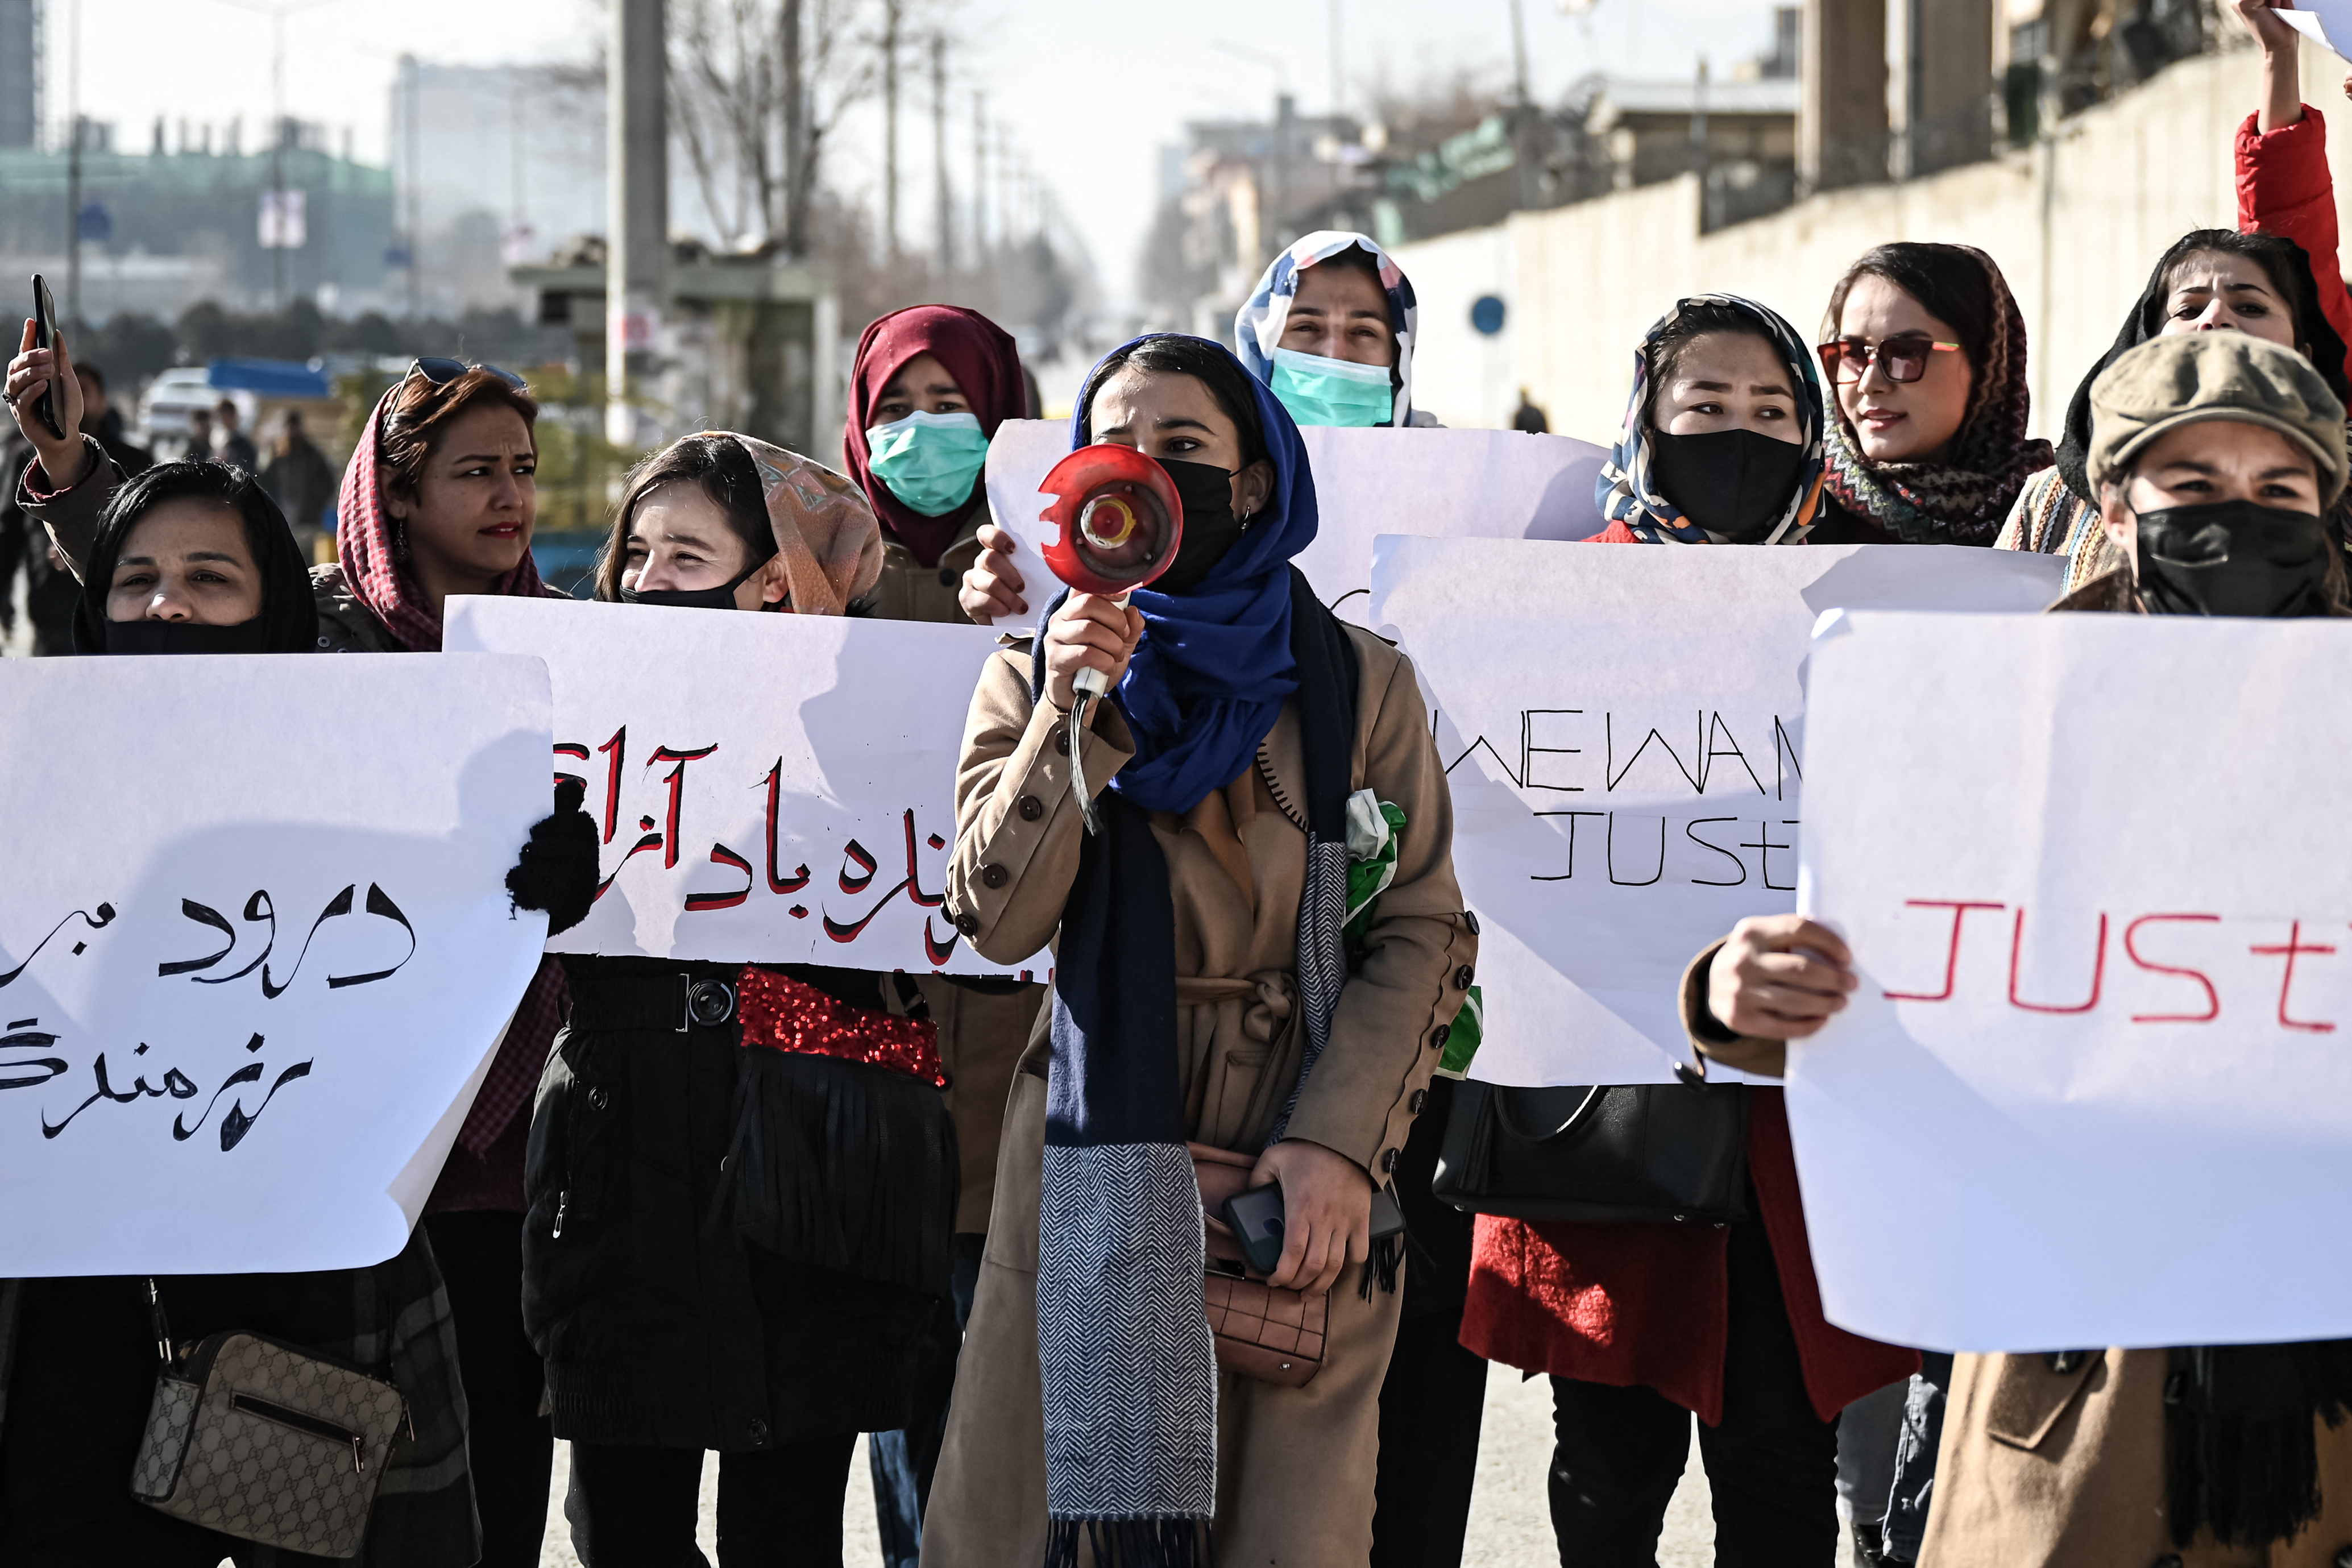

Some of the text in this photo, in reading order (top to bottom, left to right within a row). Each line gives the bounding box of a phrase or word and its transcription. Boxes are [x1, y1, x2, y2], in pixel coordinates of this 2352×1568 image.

[1433, 709, 1803, 802] WE WAN
[1530, 811, 1801, 891] JUSt
[158, 882, 416, 999] درود
[1882, 899, 2352, 1032] JUSt
